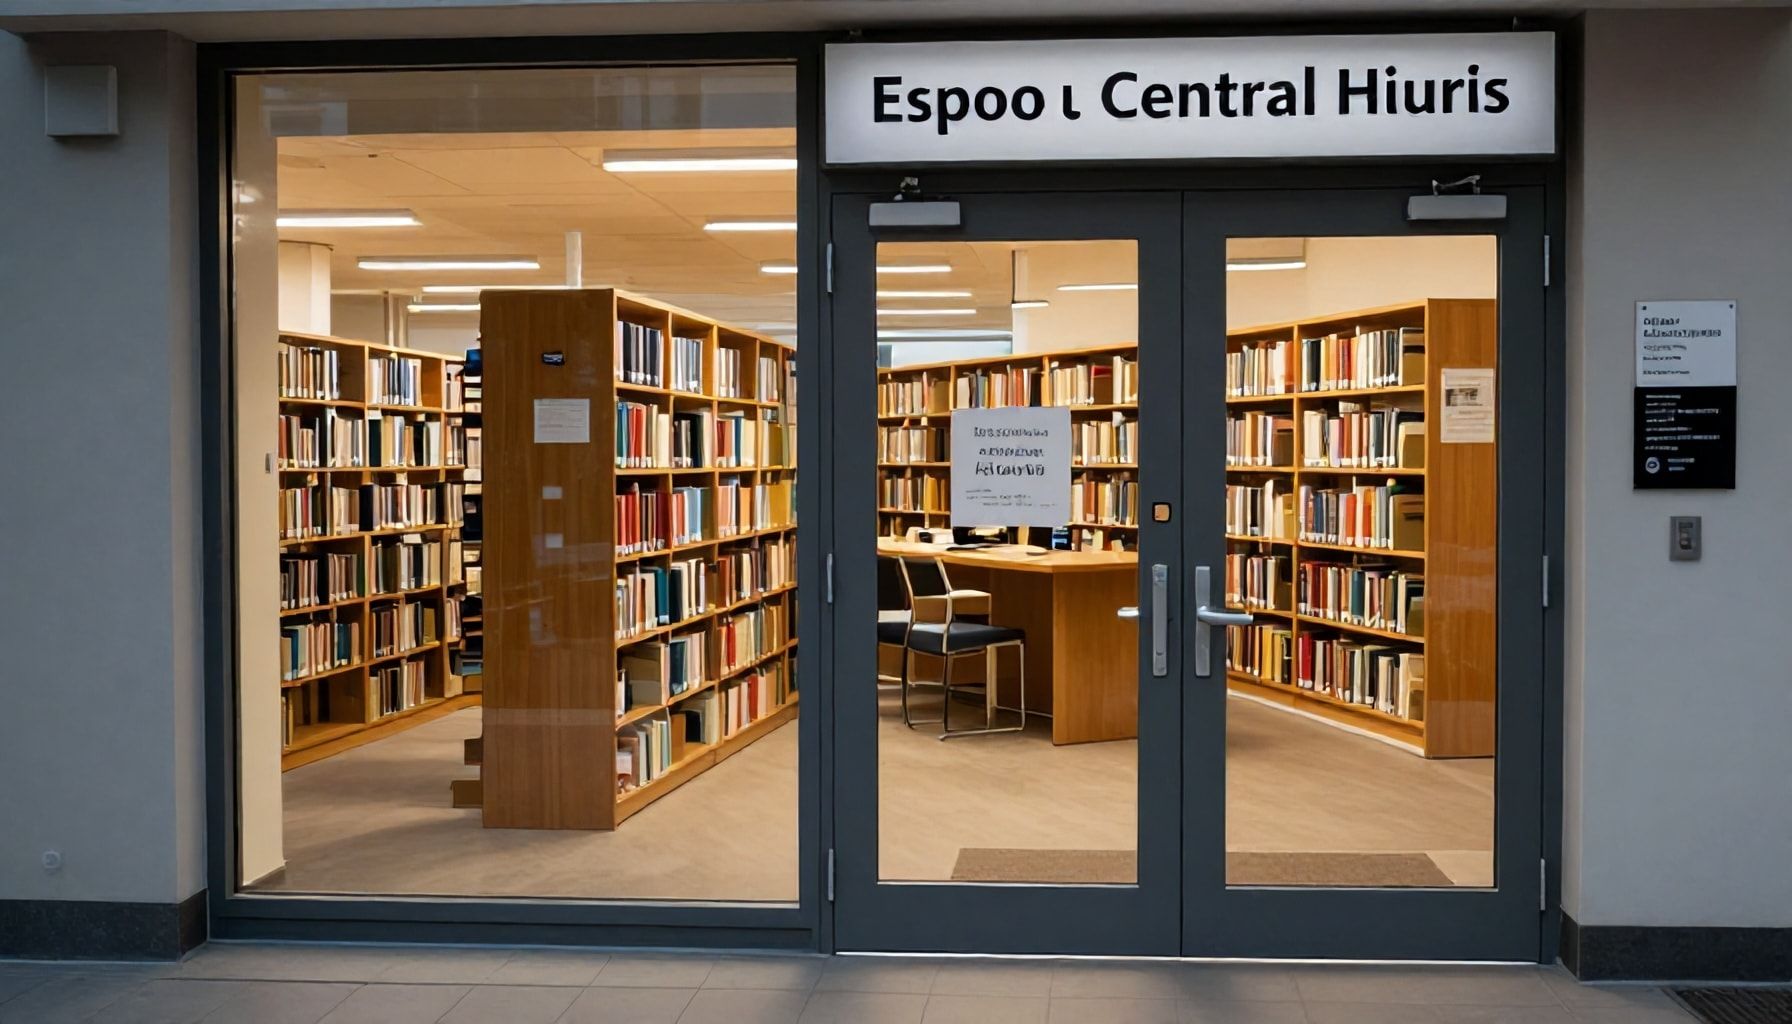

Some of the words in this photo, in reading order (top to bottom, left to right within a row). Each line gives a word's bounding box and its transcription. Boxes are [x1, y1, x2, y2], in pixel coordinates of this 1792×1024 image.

[873, 75, 1046, 136] Espoo
[1101, 65, 1315, 119] Central
[1338, 64, 1510, 115] Hiuris
